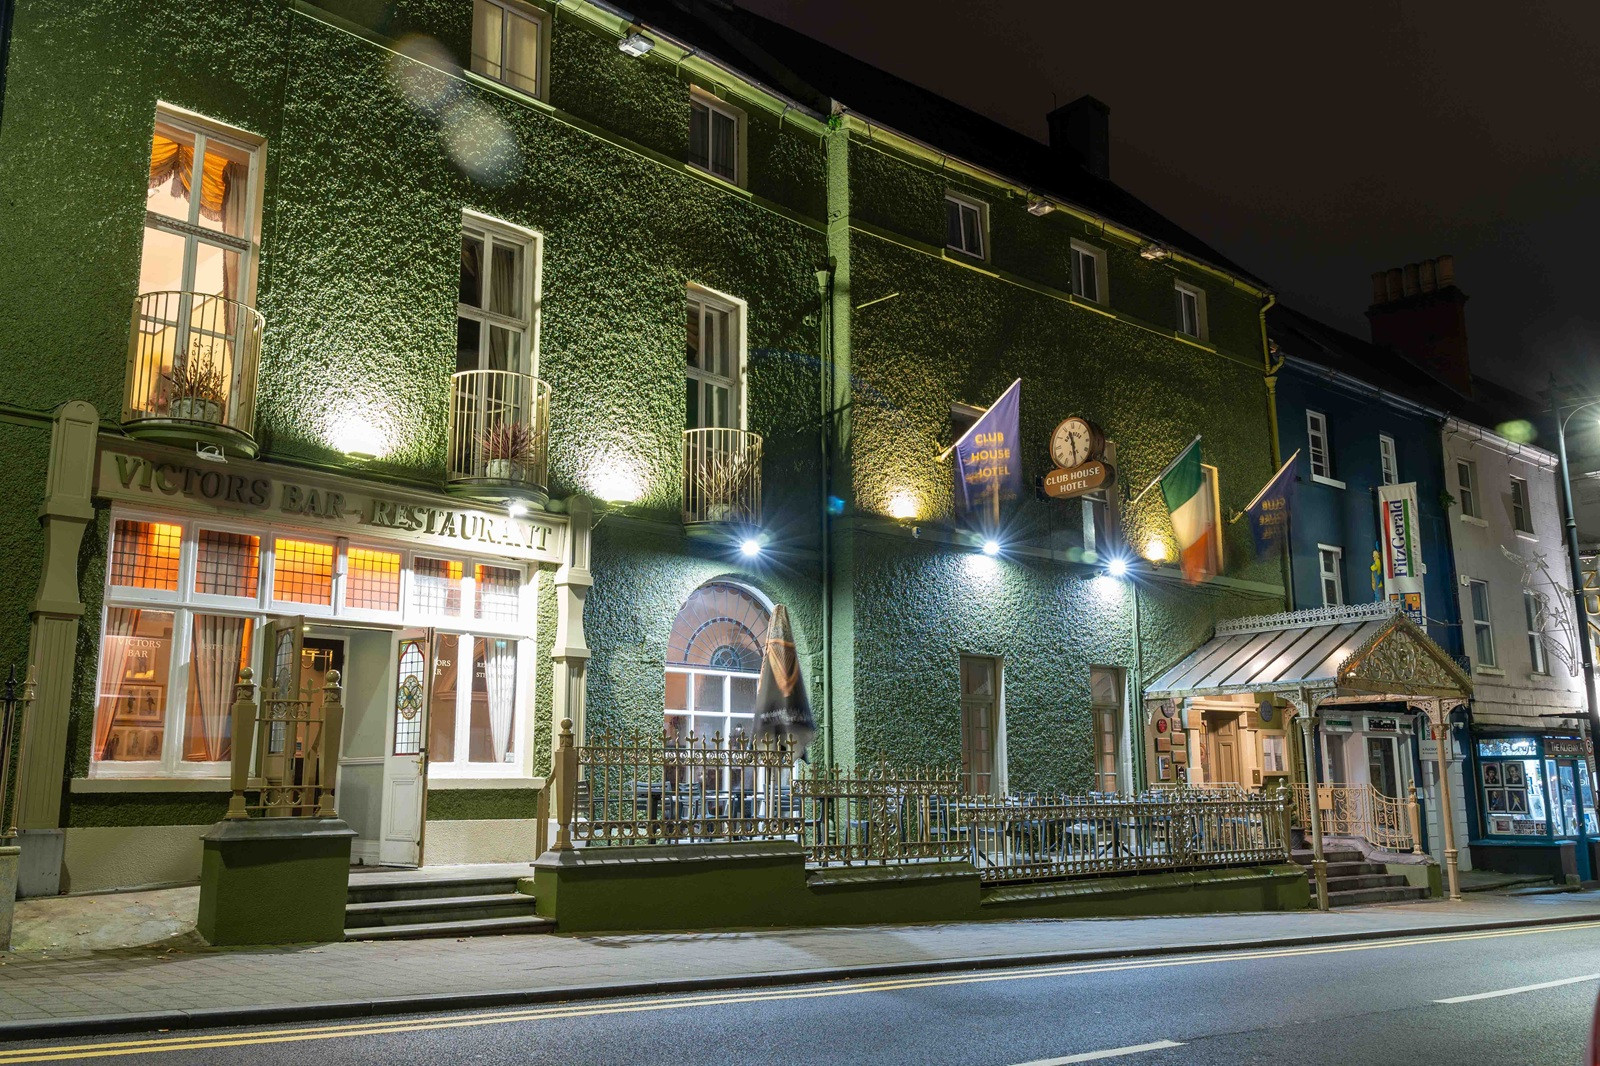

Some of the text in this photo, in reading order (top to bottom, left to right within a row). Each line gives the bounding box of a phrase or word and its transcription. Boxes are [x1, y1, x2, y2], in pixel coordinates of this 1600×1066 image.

[975, 432, 1004, 444] CLUB
[971, 449, 1011, 462] HOUSE
[1046, 466, 1101, 486] CLUB HOUSE
[115, 455, 270, 507] VICTORS
[281, 484, 345, 519] BAR
[1060, 480, 1089, 492] HOTEL
[1390, 500, 1408, 577] FitzGerald
[117, 637, 161, 648] VICTORS
[128, 650, 148, 658] BAR
